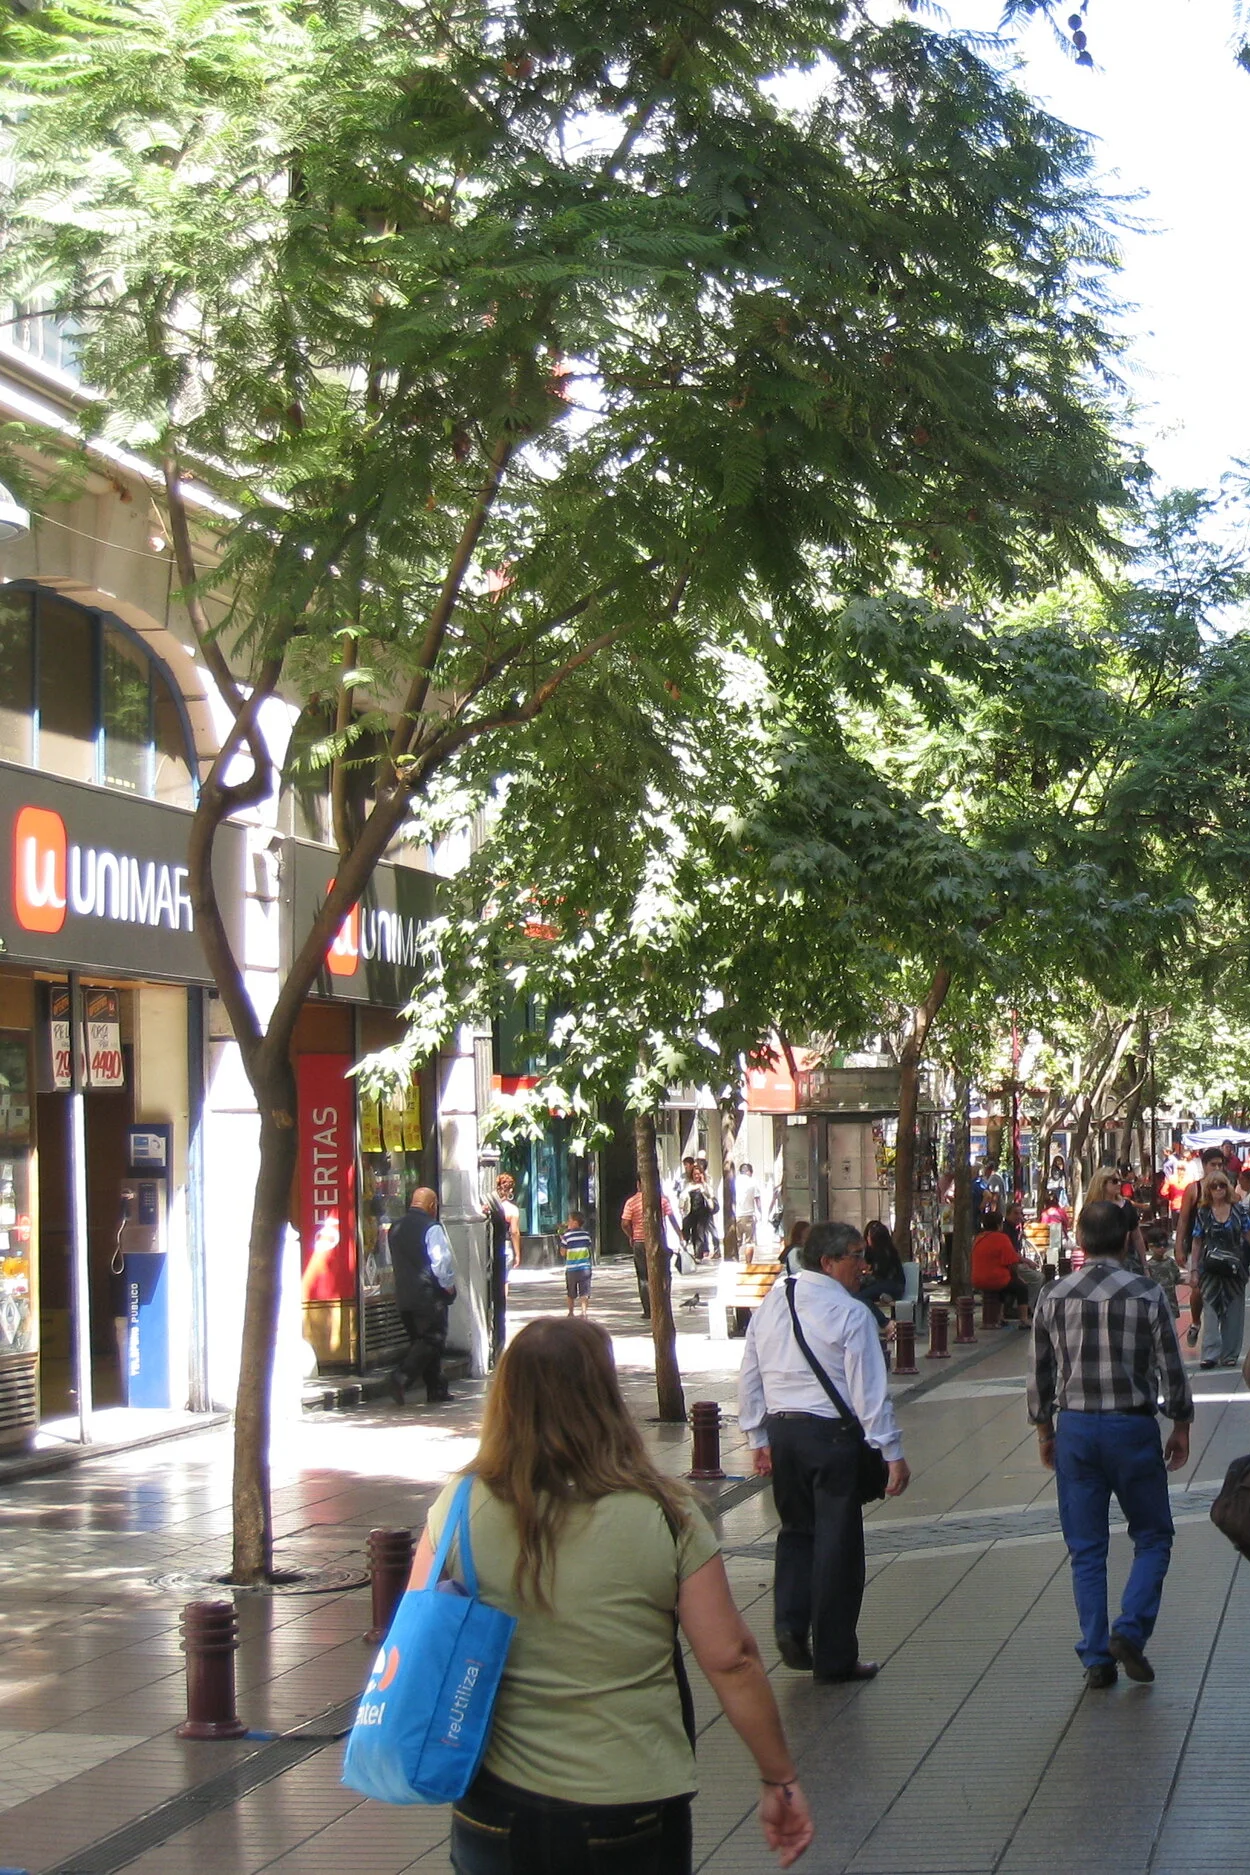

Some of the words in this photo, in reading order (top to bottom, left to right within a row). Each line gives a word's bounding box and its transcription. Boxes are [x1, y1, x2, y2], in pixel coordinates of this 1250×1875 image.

[71, 846, 193, 931] UNIMAR
[361, 907, 430, 968] UNIMA
[91, 1050, 122, 1079] 4490
[131, 1282, 139, 1323] PUBLICO
